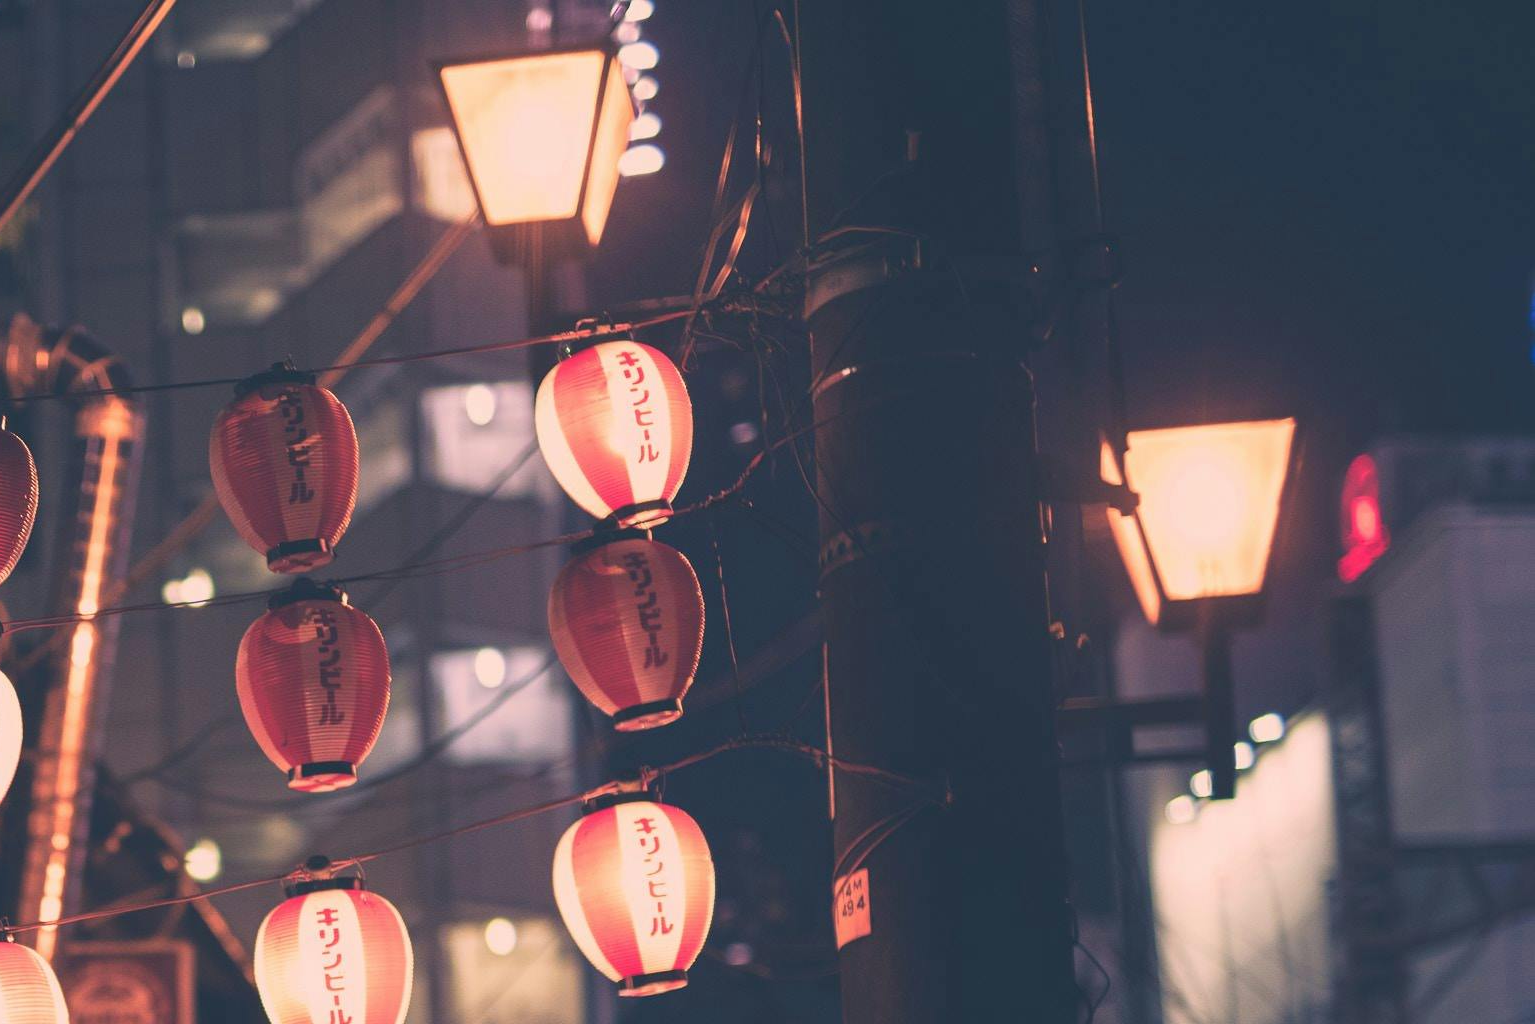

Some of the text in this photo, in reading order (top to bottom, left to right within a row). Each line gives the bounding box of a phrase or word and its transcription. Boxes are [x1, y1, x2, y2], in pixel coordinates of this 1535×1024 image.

[279, 386, 313, 504] キリンビール
[313, 607, 344, 725] キリンビール
[626, 551, 668, 670] キリンビール
